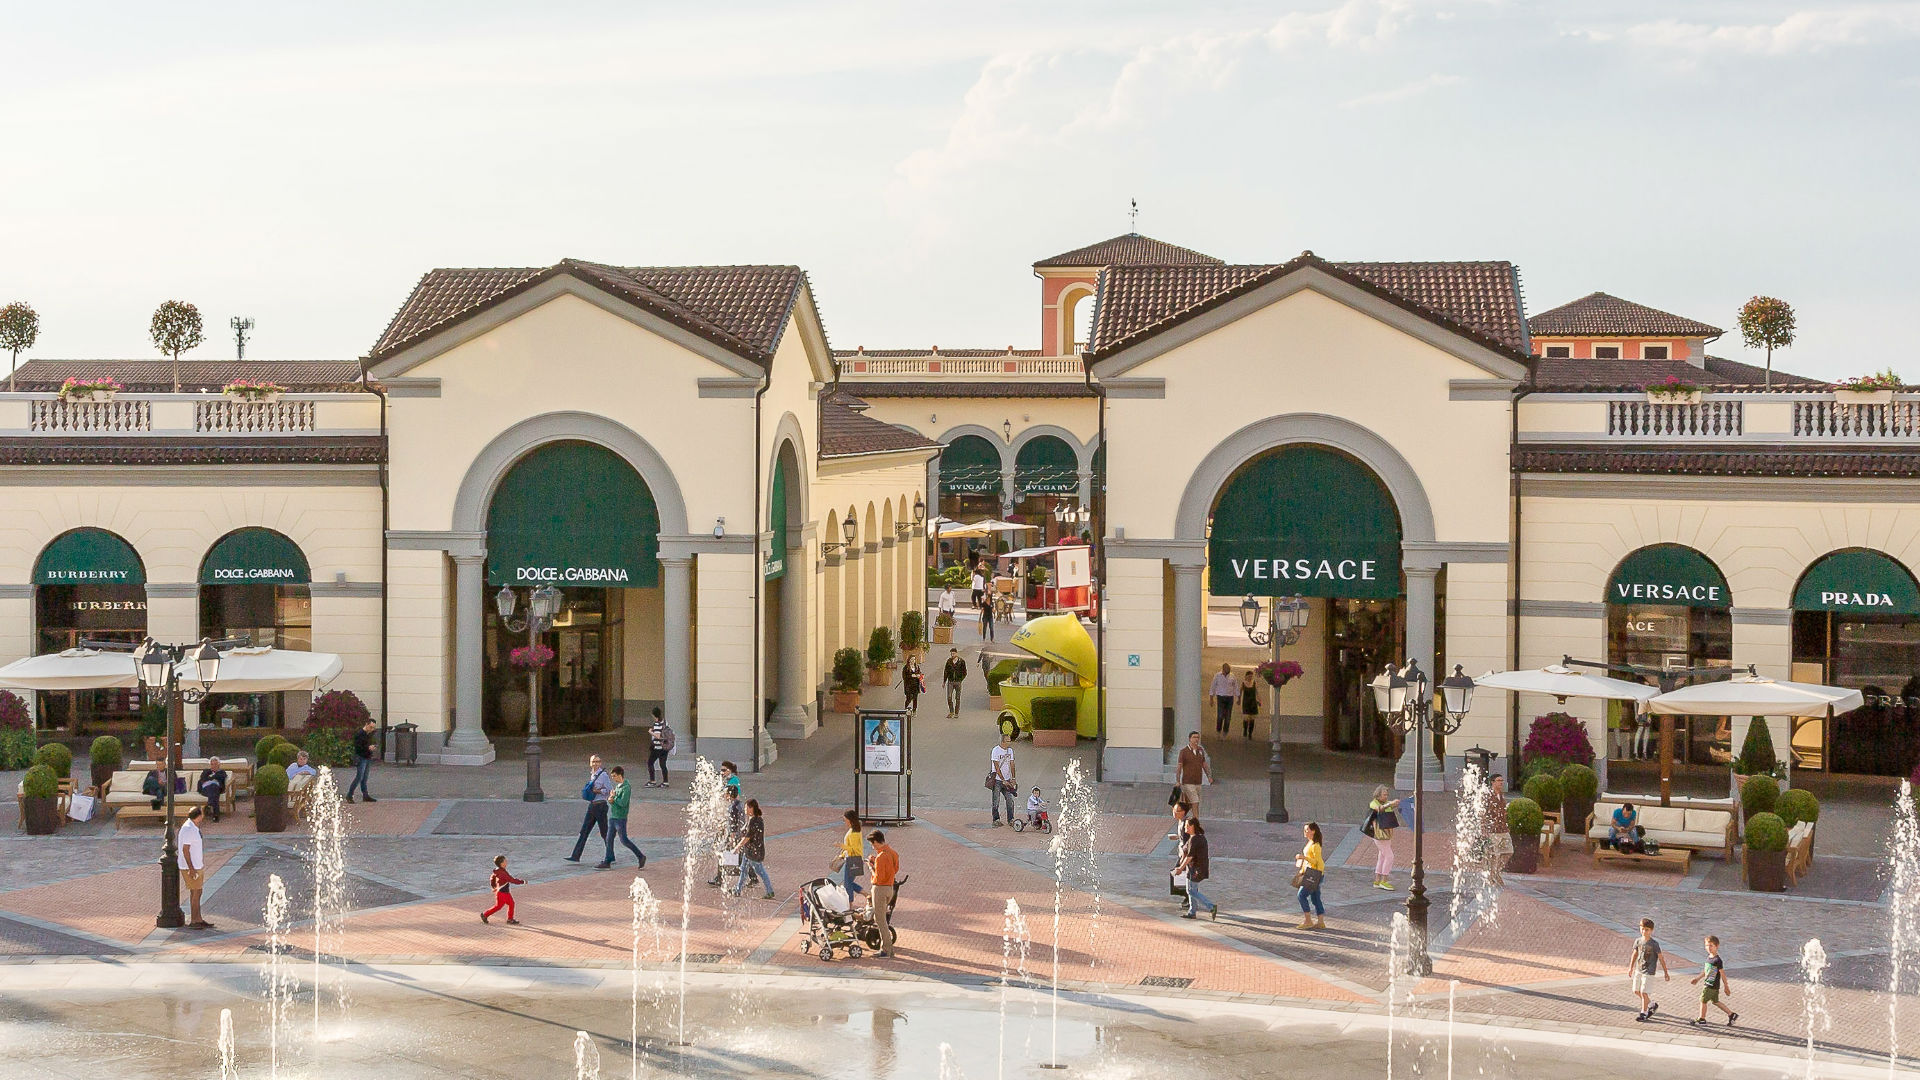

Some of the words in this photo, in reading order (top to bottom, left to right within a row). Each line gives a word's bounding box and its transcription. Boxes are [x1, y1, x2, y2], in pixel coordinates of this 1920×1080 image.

[47, 570, 129, 579] BURBERRY
[1231, 558, 1376, 580] VERSACE
[1617, 583, 1720, 601] VERSACE
[1821, 591, 1894, 606] PRADA
